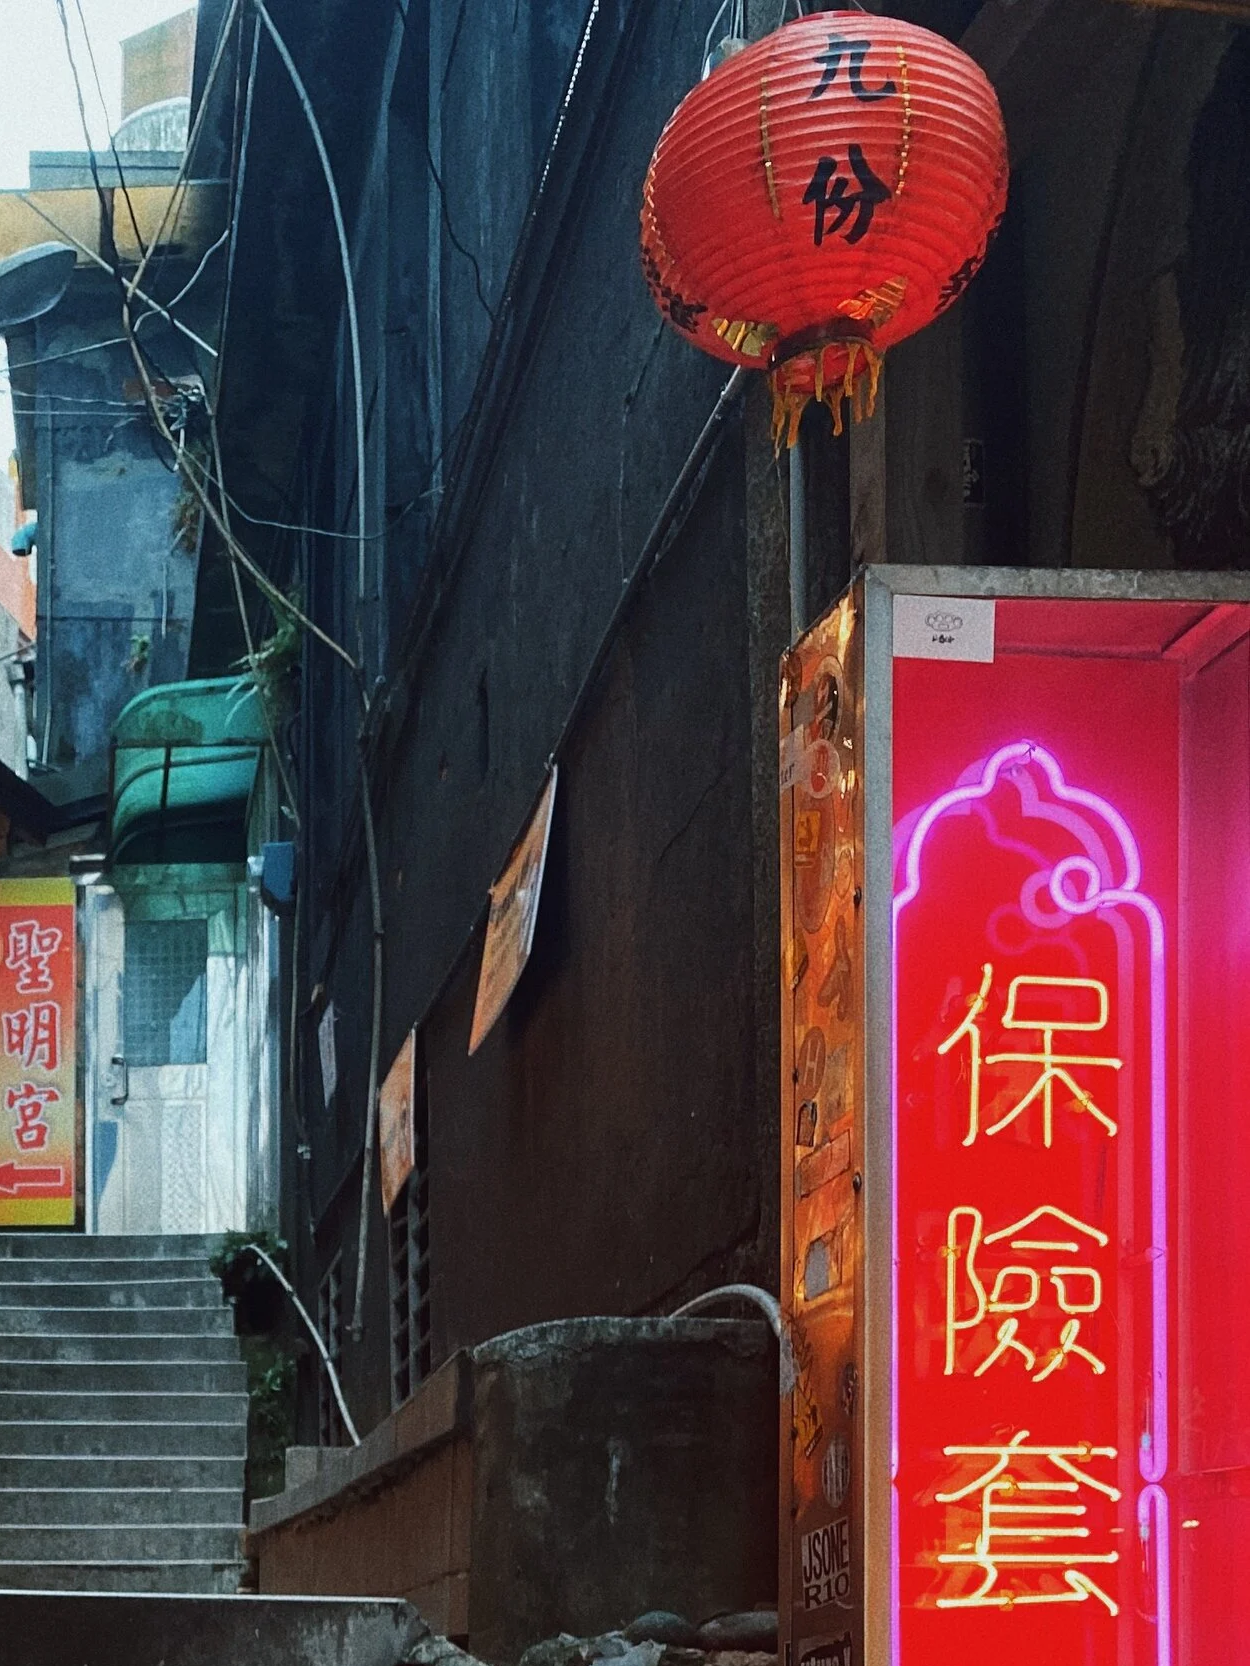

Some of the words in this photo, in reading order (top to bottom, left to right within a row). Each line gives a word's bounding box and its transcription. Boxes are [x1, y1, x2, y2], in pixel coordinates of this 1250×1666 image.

[803, 33, 897, 246] 九份
[2, 920, 64, 1153] 聖明宮
[803, 1519, 849, 1584] JSONE
[804, 1572, 850, 1610] R10
